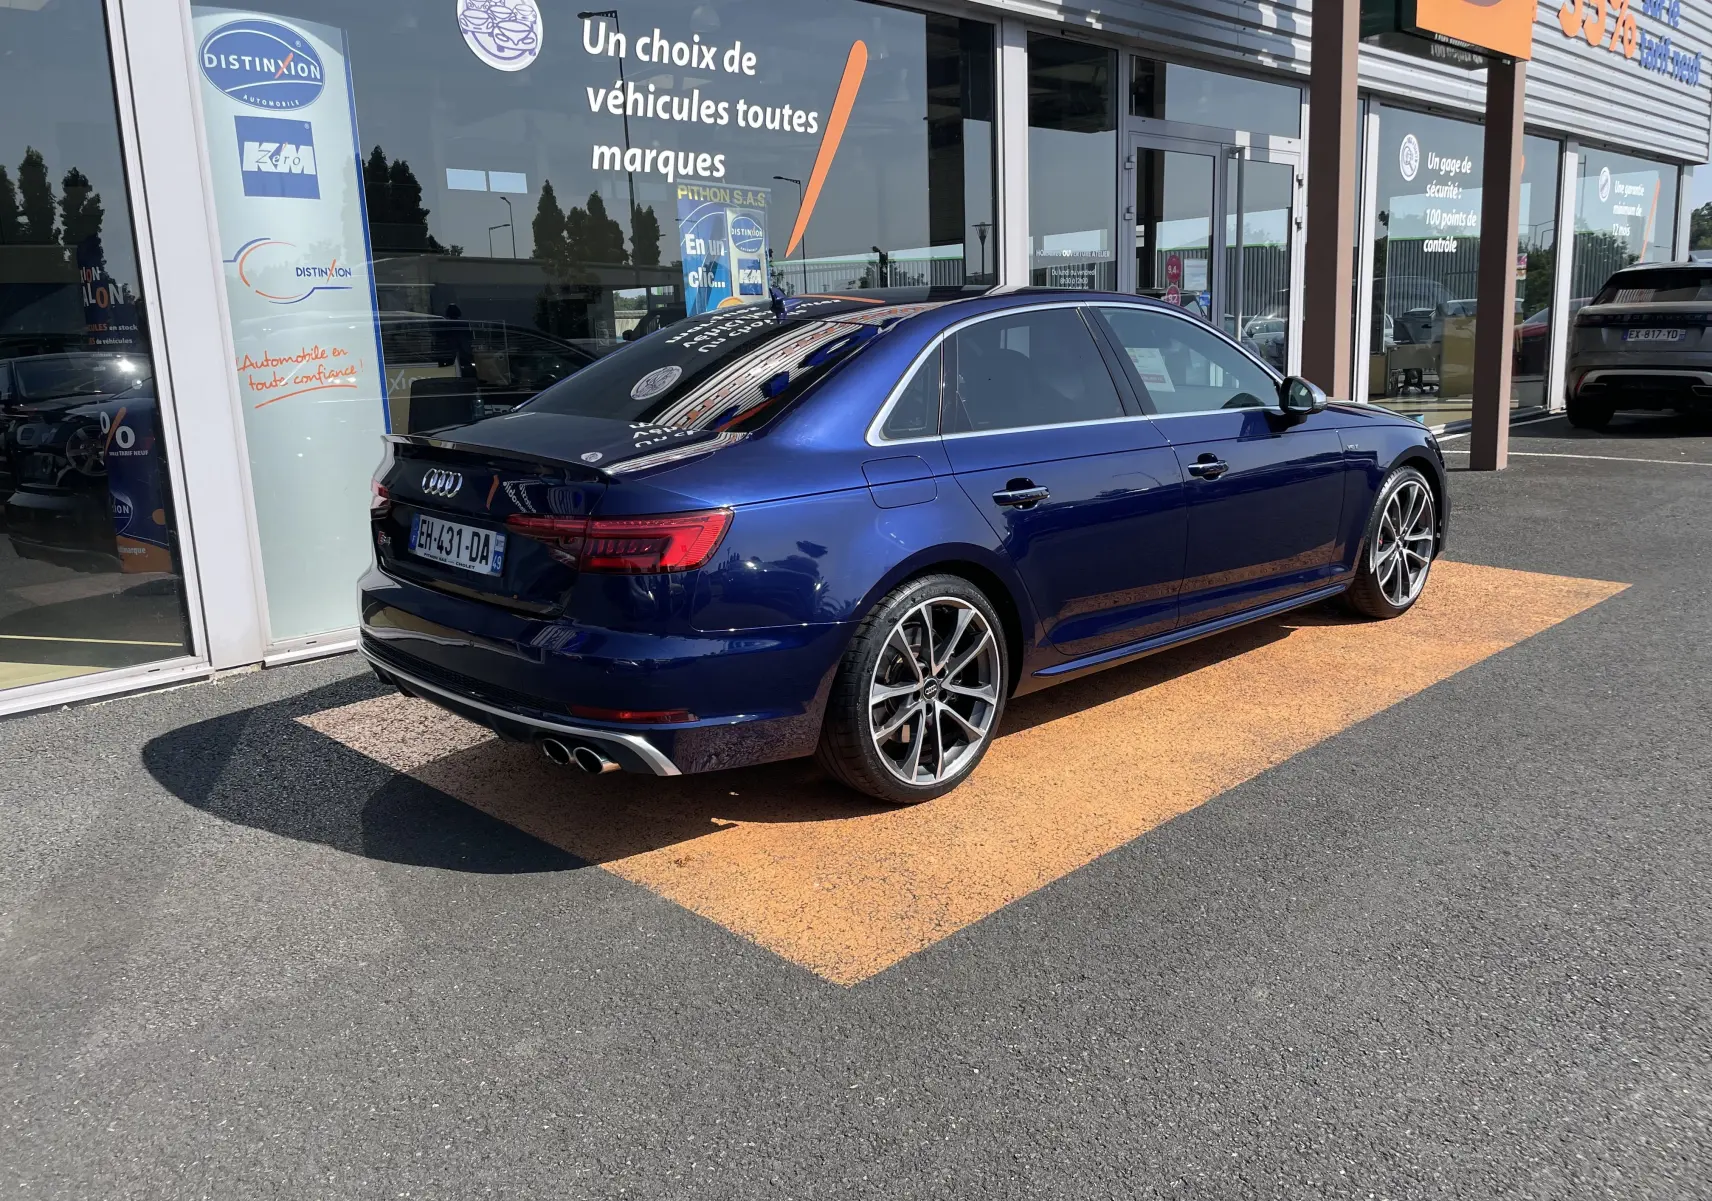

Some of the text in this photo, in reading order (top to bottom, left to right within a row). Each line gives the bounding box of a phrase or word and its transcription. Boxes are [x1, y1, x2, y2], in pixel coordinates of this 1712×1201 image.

[582, 19, 757, 76] Un choix de
[1640, 29, 1671, 73] tarif
[1673, 52, 1702, 85] neuf
[204, 53, 321, 79] DISTINXION
[243, 94, 300, 107] AUTOMOBILE
[587, 80, 818, 134] véhicules toutes
[591, 145, 726, 182] marques
[1427, 152, 1472, 176] Un gage de
[677, 185, 730, 203] PITHON
[1615, 180, 1644, 197] Une garantie
[1613, 201, 1642, 216] minimum de
[1425, 209, 1476, 229] 100 points de
[1612, 224, 1630, 236] 12 mois
[685, 233, 725, 256] En un
[1423, 237, 1457, 253] contrôle
[1091, 250, 1110, 258] ATELIER
[296, 263, 352, 280] DISTINXION
[102, 337, 133, 345] véhicules
[1628, 329, 1678, 339] EX-817-YD
[332, 347, 348, 357] en
[249, 371, 288, 392] toute
[293, 364, 357, 385] confiance
[418, 519, 490, 566] EH-431-DA
[455, 561, 475, 570] CHOLET
[492, 555, 502, 570] 49
